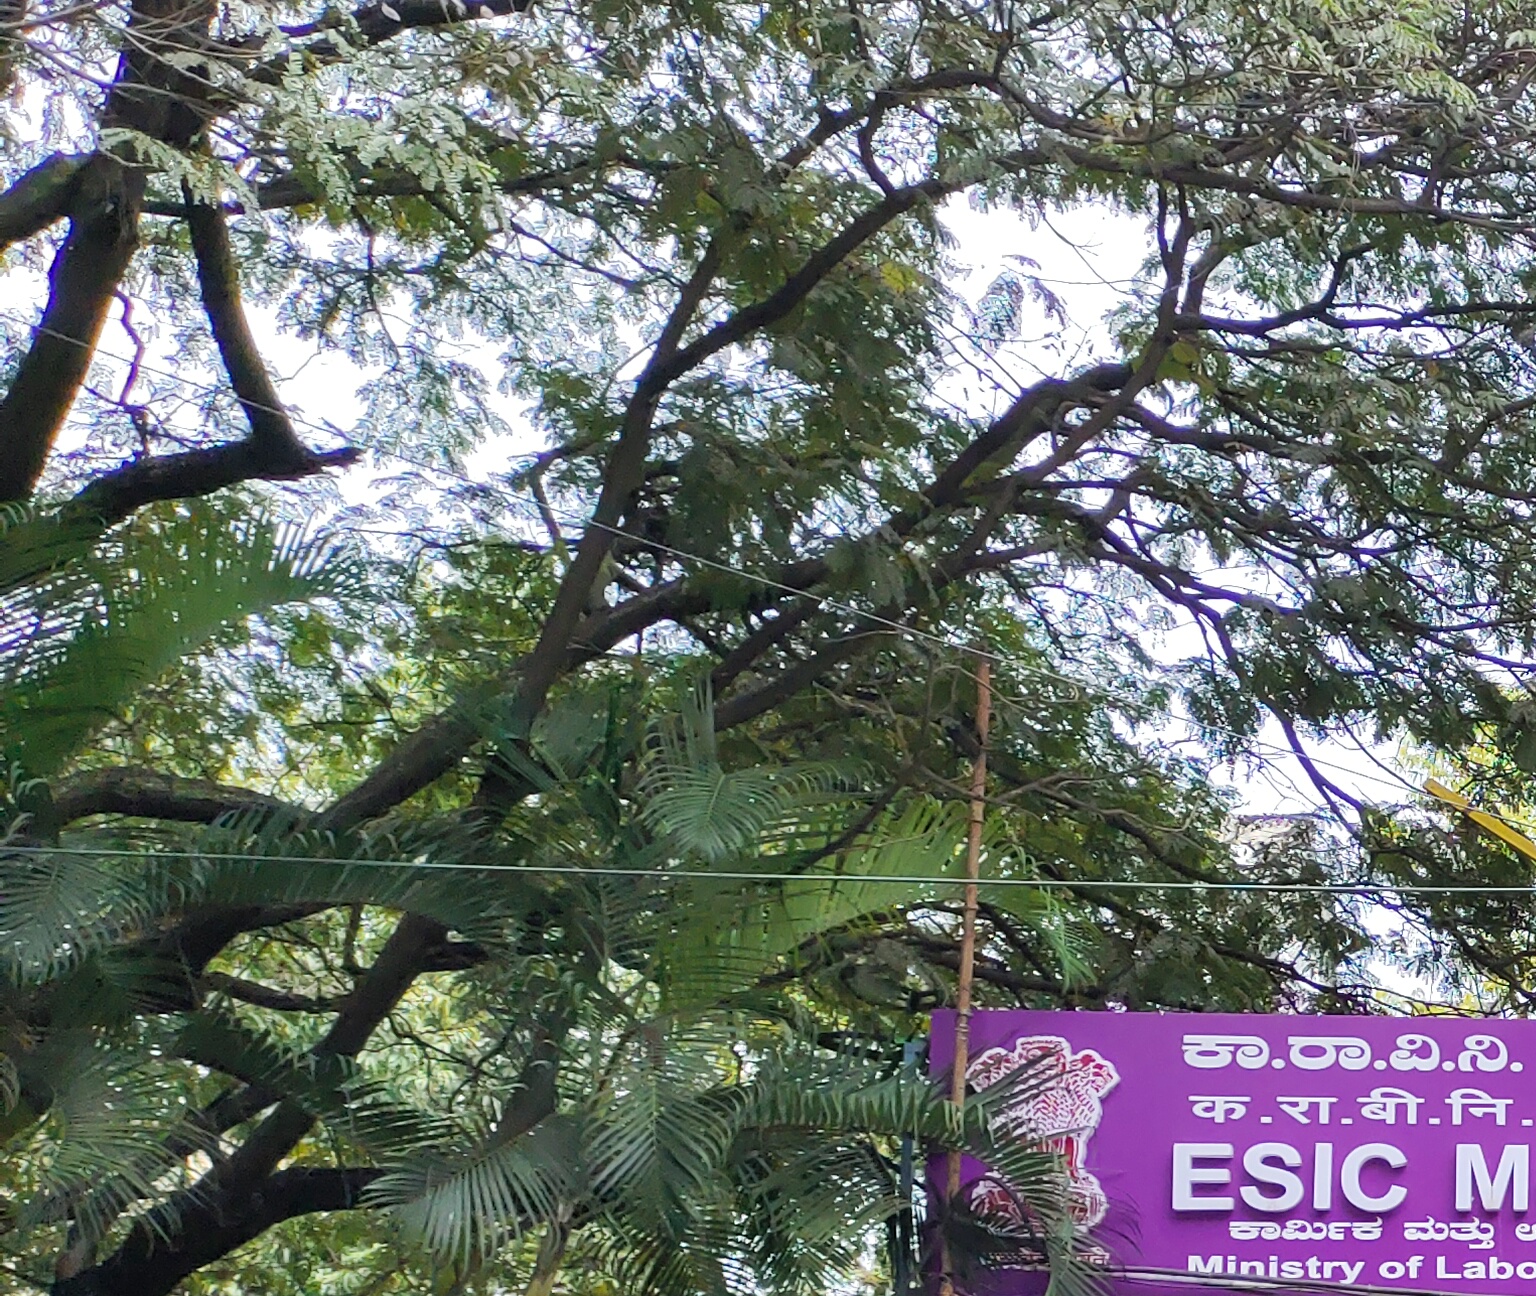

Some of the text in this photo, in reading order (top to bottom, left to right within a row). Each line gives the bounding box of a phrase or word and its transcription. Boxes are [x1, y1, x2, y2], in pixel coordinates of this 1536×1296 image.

[1181, 1033, 1524, 1073] ಕಾ.ರಾ.ವಿ.ನಿ.
[1172, 1142, 1408, 1212] ESIC
[1228, 1217, 1383, 1241] ಕಾರ್ಮಿಕ
[1403, 1215, 1495, 1250] ಮತ್ತು
[1187, 1255, 1365, 1284] Ministry
[1378, 1255, 1425, 1279] of
